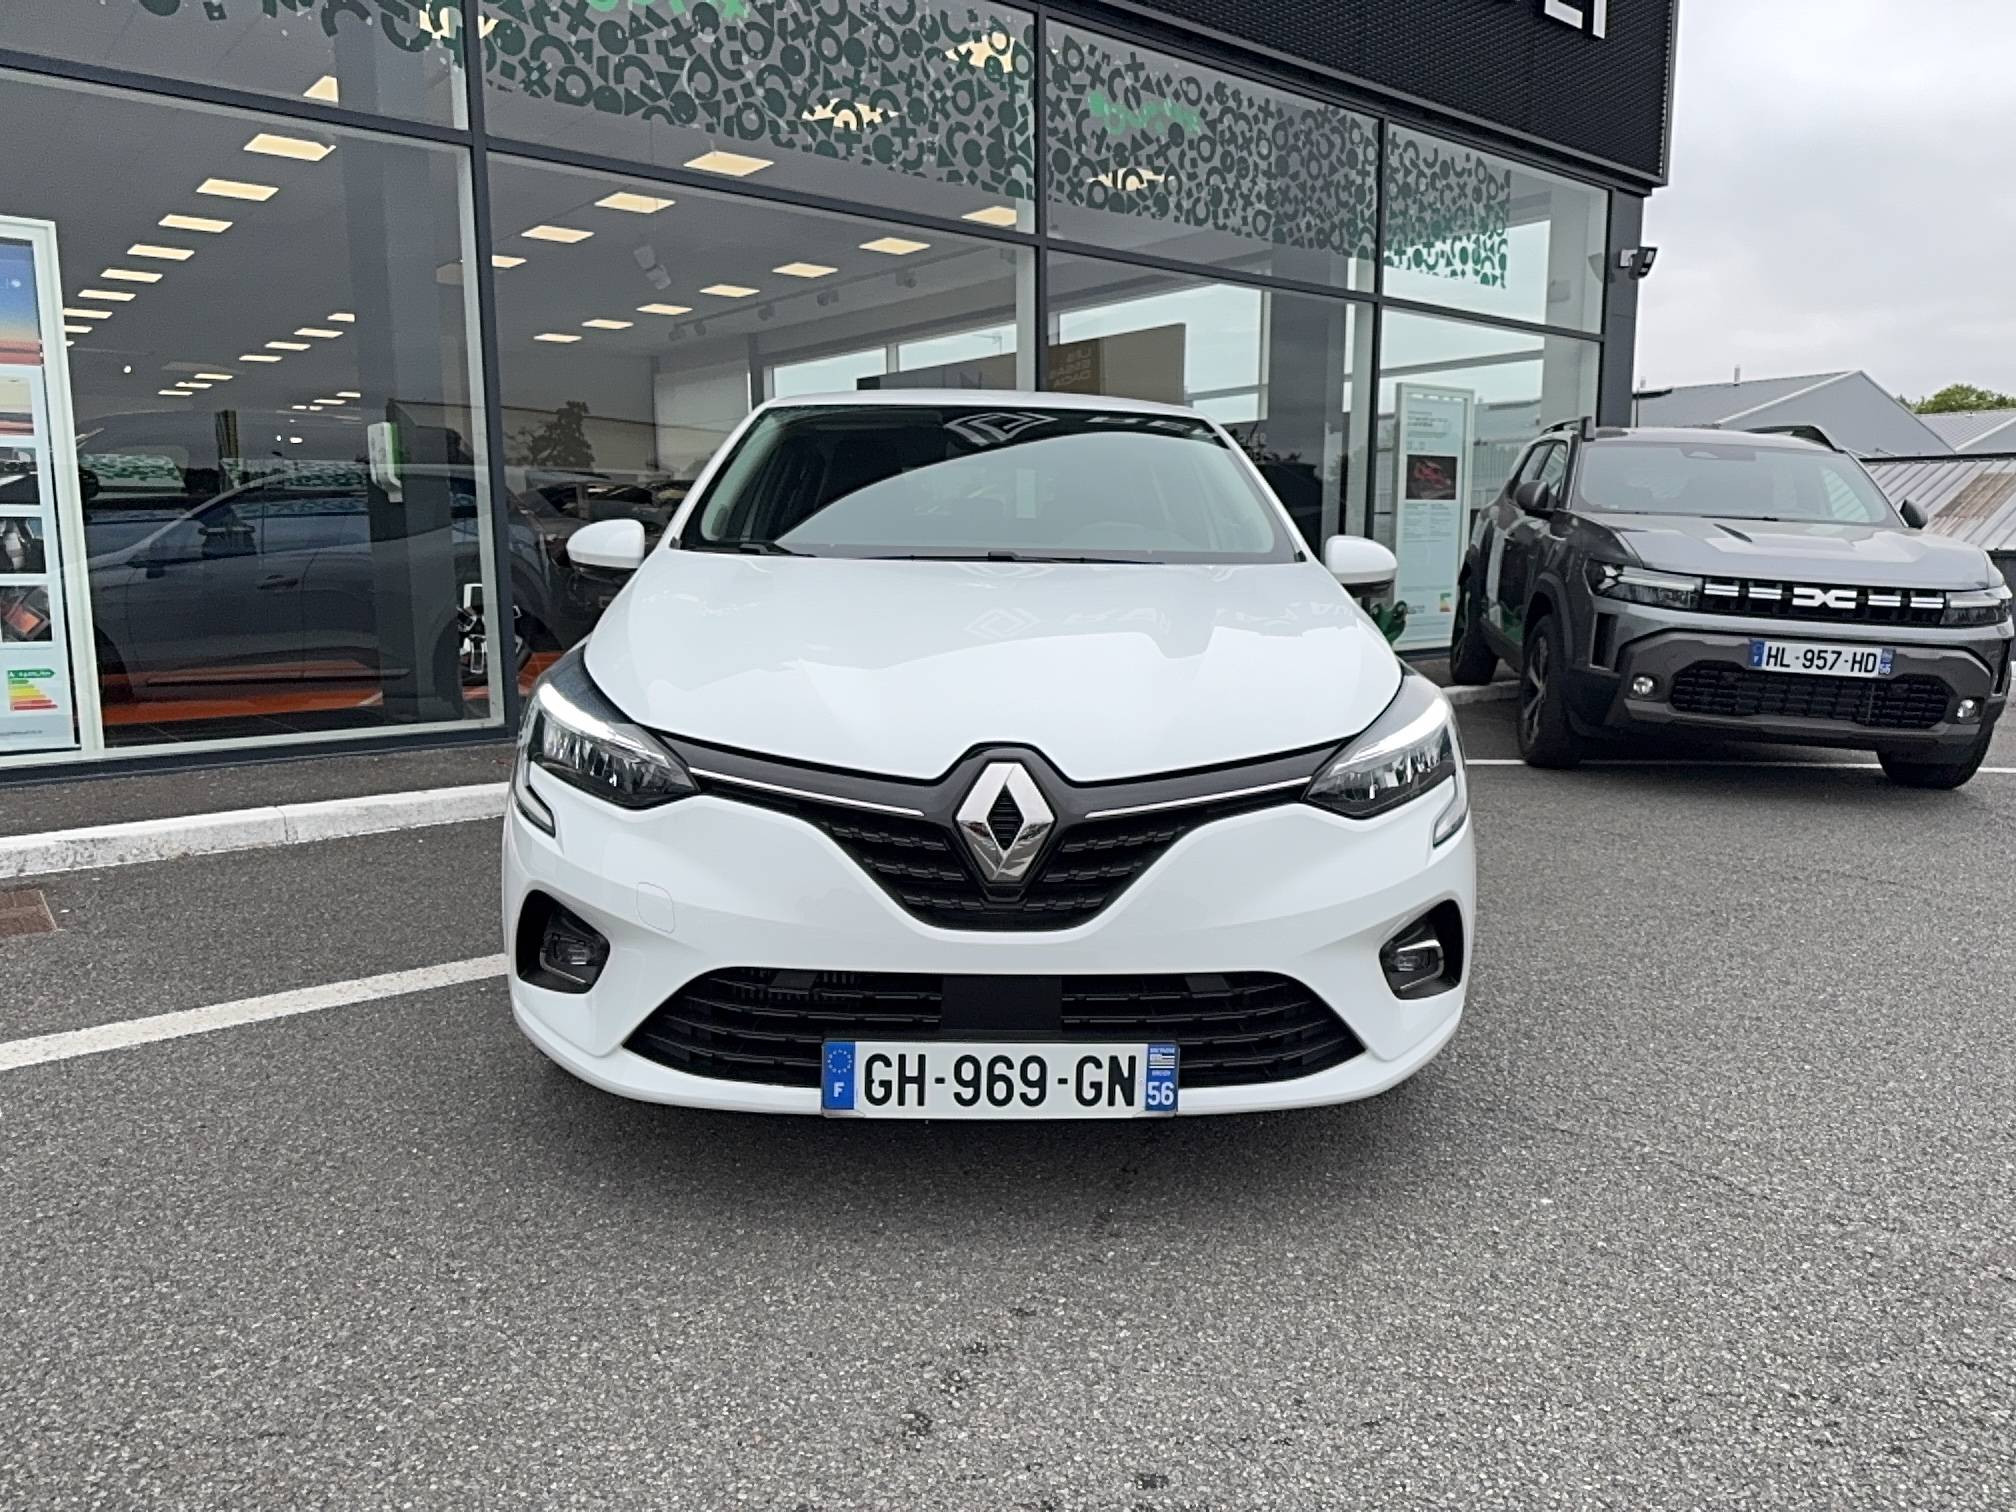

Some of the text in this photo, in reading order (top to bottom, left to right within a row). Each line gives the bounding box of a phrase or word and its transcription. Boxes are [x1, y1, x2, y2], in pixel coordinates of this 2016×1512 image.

[1765, 646, 1878, 673] HL-957-HD
[832, 1082, 845, 1097] F
[864, 1053, 1137, 1107] GH-969-GN
[1147, 1081, 1175, 1106] 56
